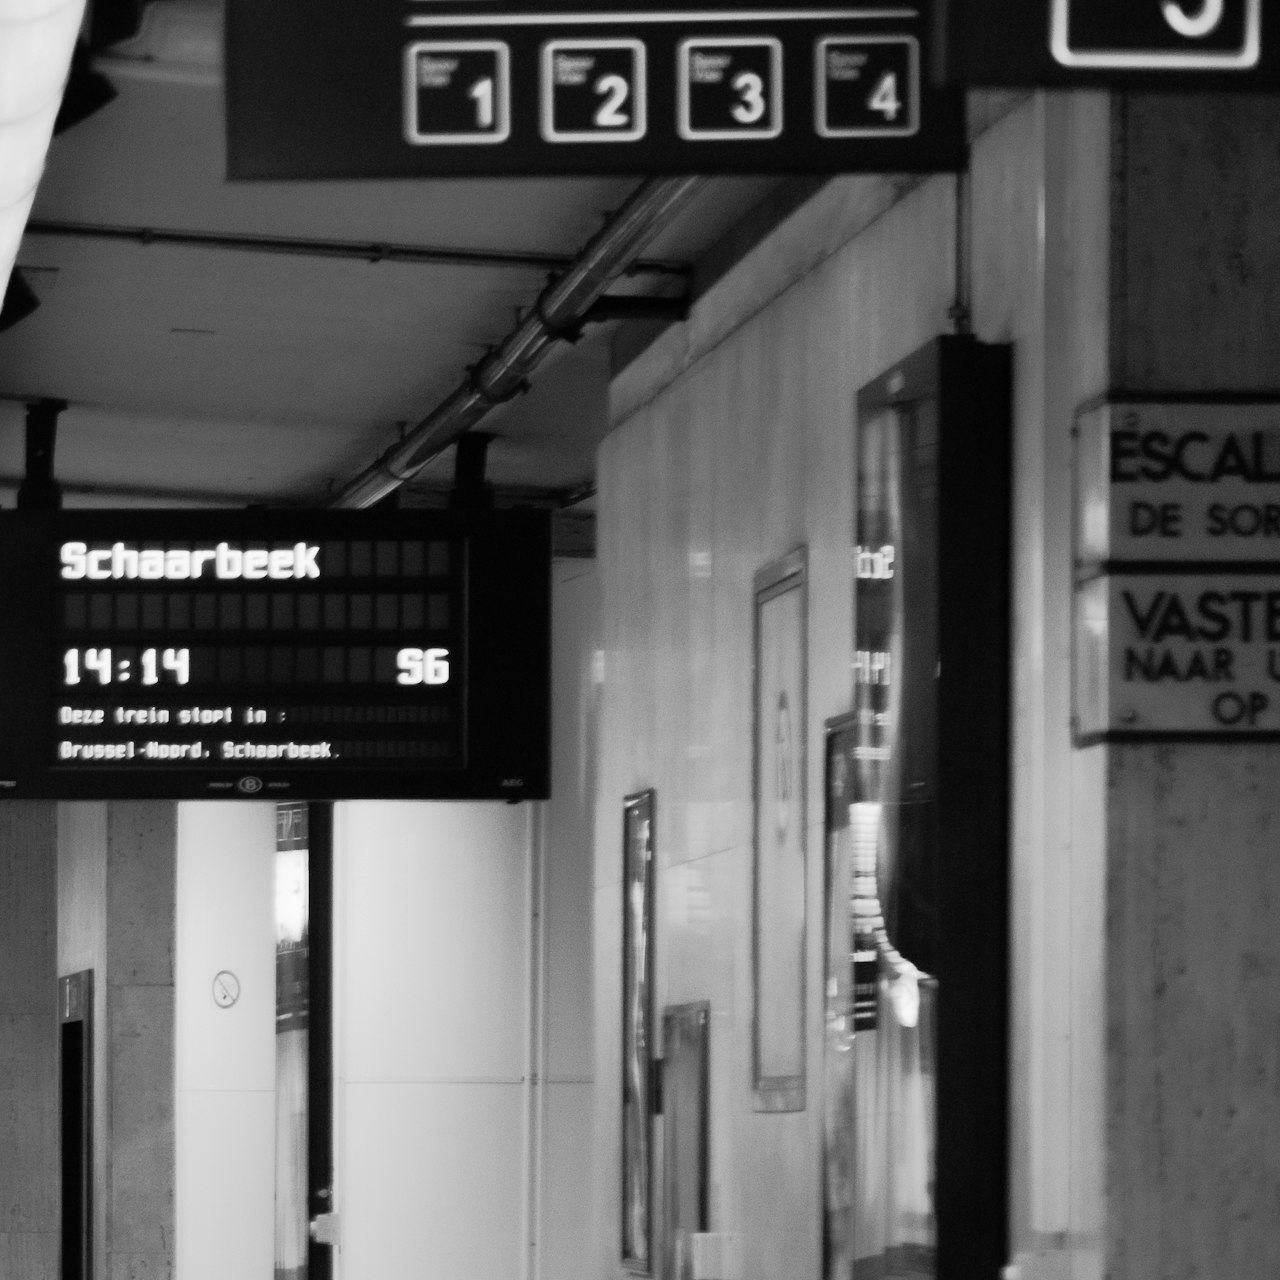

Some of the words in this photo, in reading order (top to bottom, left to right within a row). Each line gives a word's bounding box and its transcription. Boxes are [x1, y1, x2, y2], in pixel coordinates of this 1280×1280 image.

[468, 75, 494, 129] 1
[592, 73, 630, 127] 2
[730, 71, 765, 125] 3
[866, 70, 902, 121] 4
[1130, 500, 1182, 538] DE
[59, 541, 322, 580] Schaarbeek
[62, 647, 191, 686] 14:14
[395, 647, 451, 686] S6
[1123, 646, 1236, 683] NAAR
[58, 706, 105, 724] Deze
[114, 706, 171, 724] trein
[177, 706, 233, 724] stopt
[244, 706, 268, 724] in
[1211, 690, 1270, 726] OP
[501, 778, 525, 788] AEG
